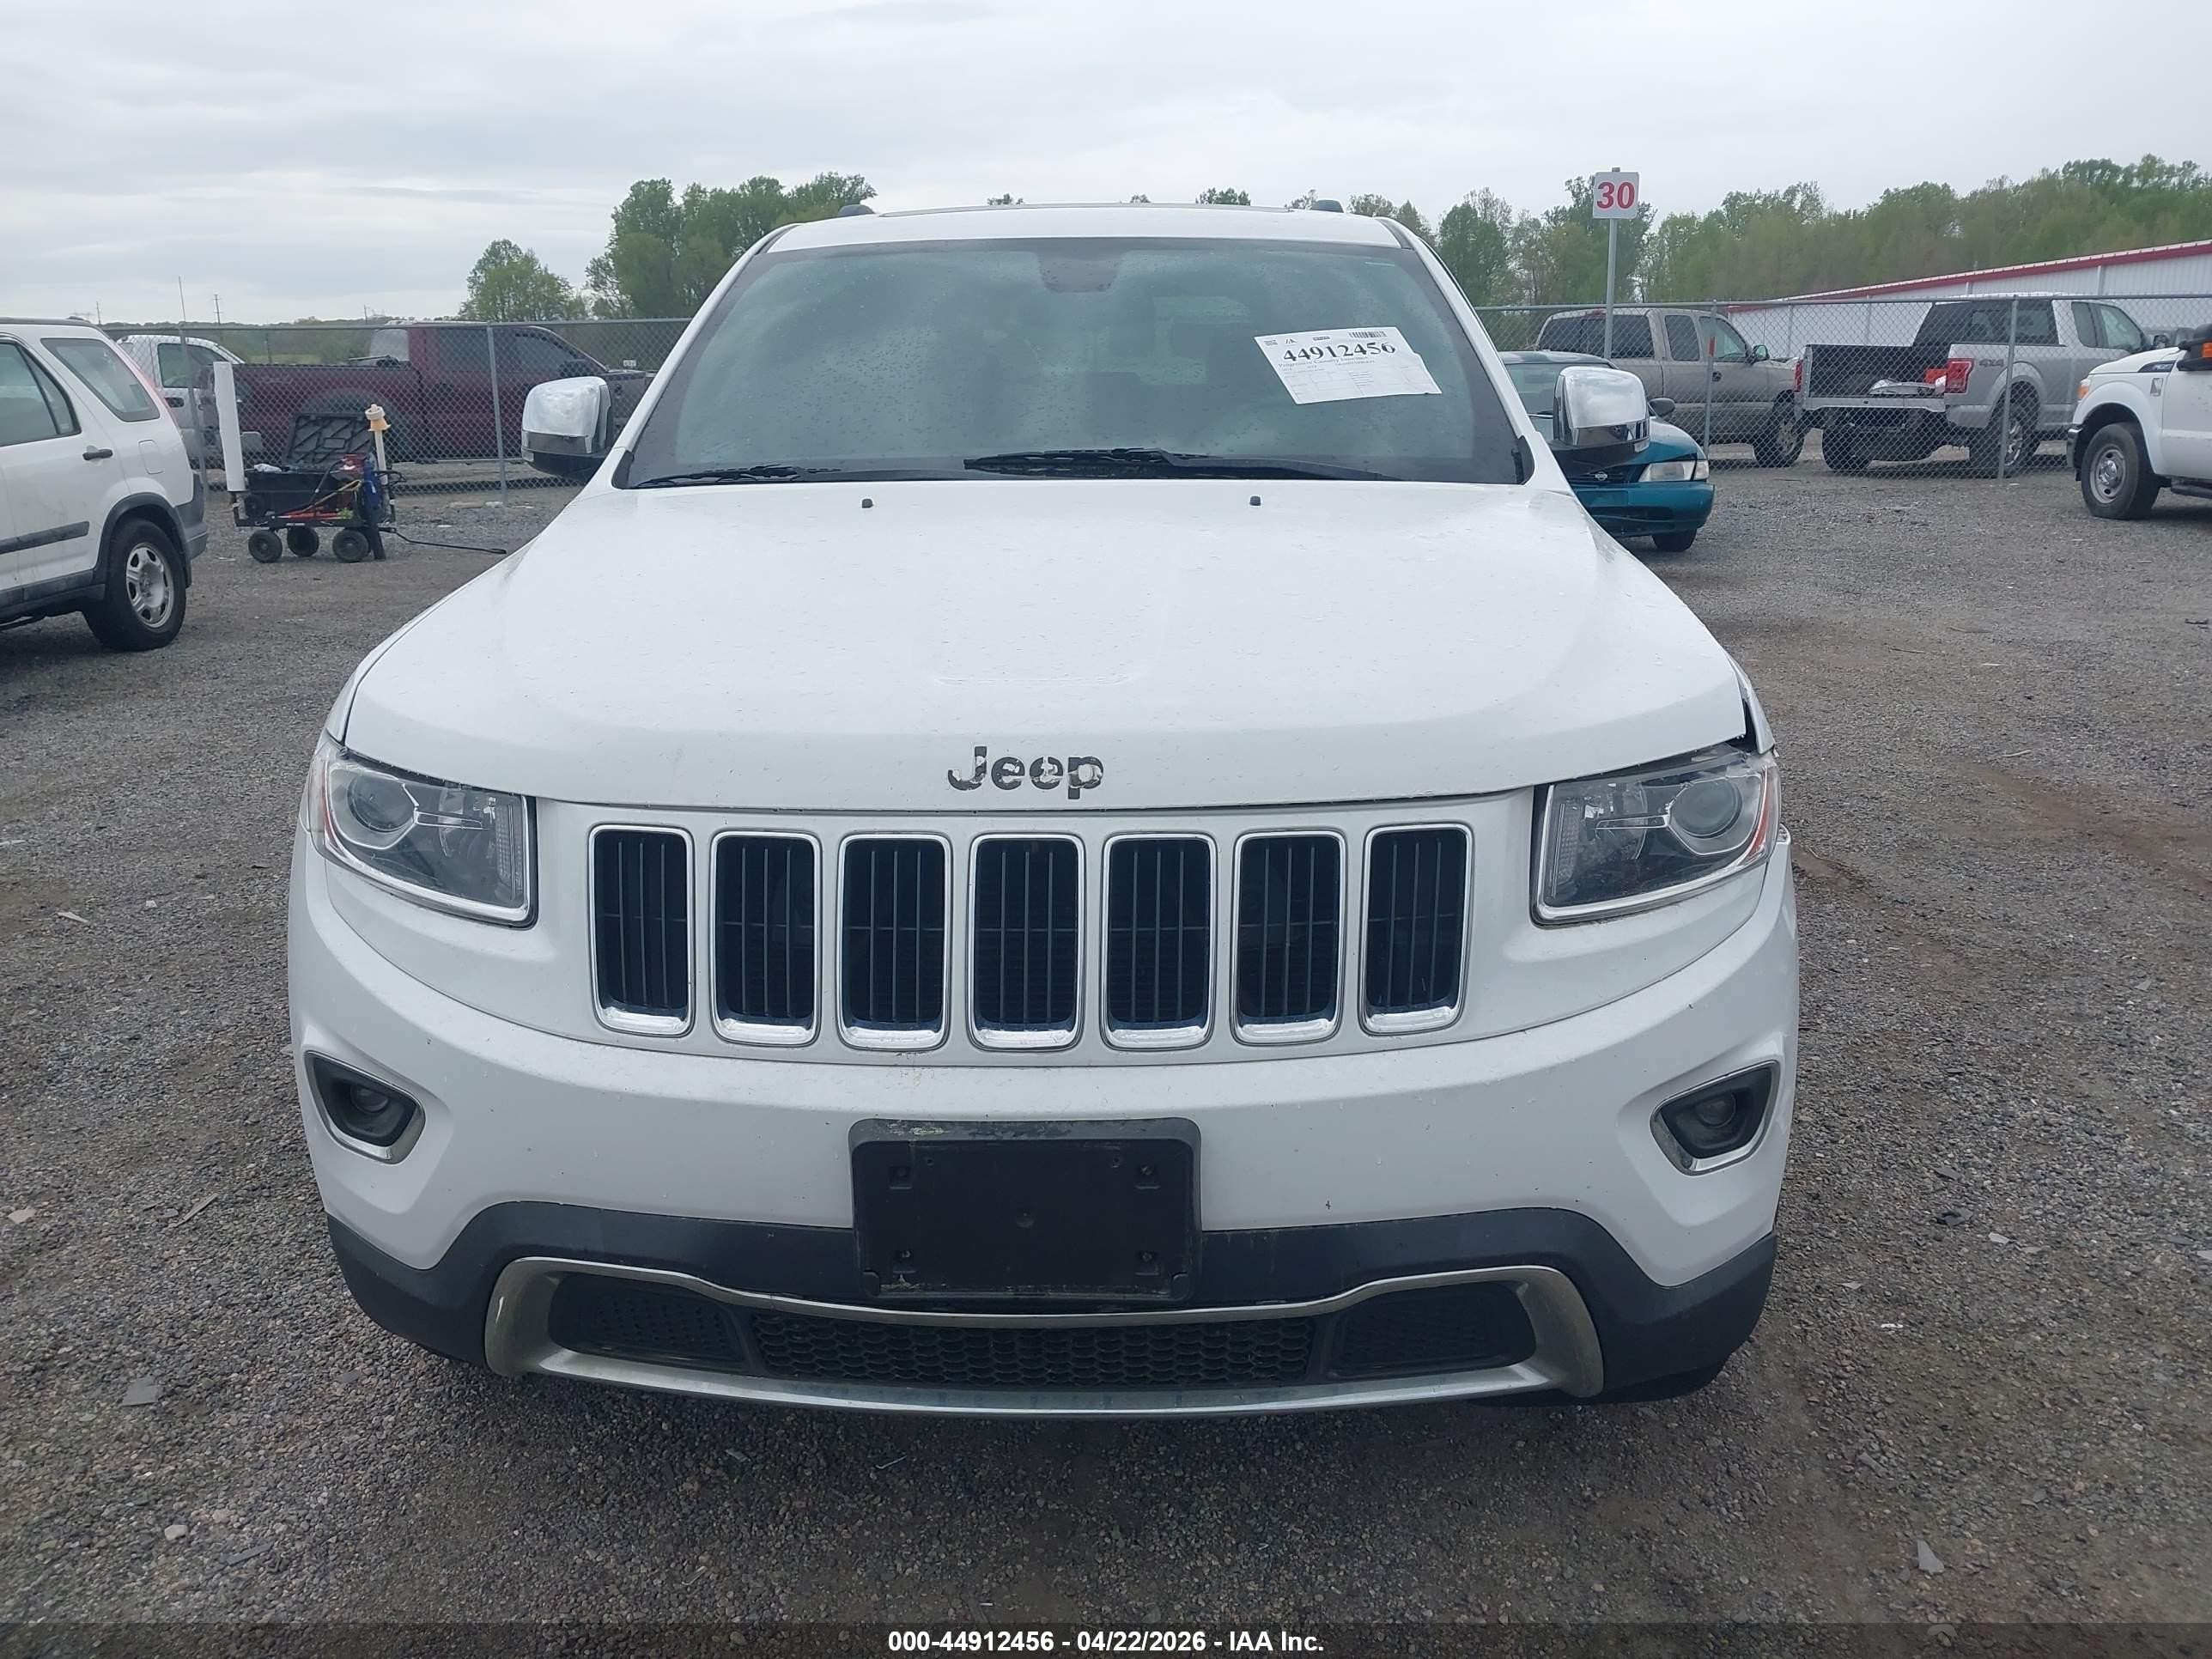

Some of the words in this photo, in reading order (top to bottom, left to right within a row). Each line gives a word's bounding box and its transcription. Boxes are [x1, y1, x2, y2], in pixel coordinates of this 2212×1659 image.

[1597, 182, 1635, 209] 30
[1283, 342, 1396, 362] 44912456
[948, 746, 1104, 799] Jeep
